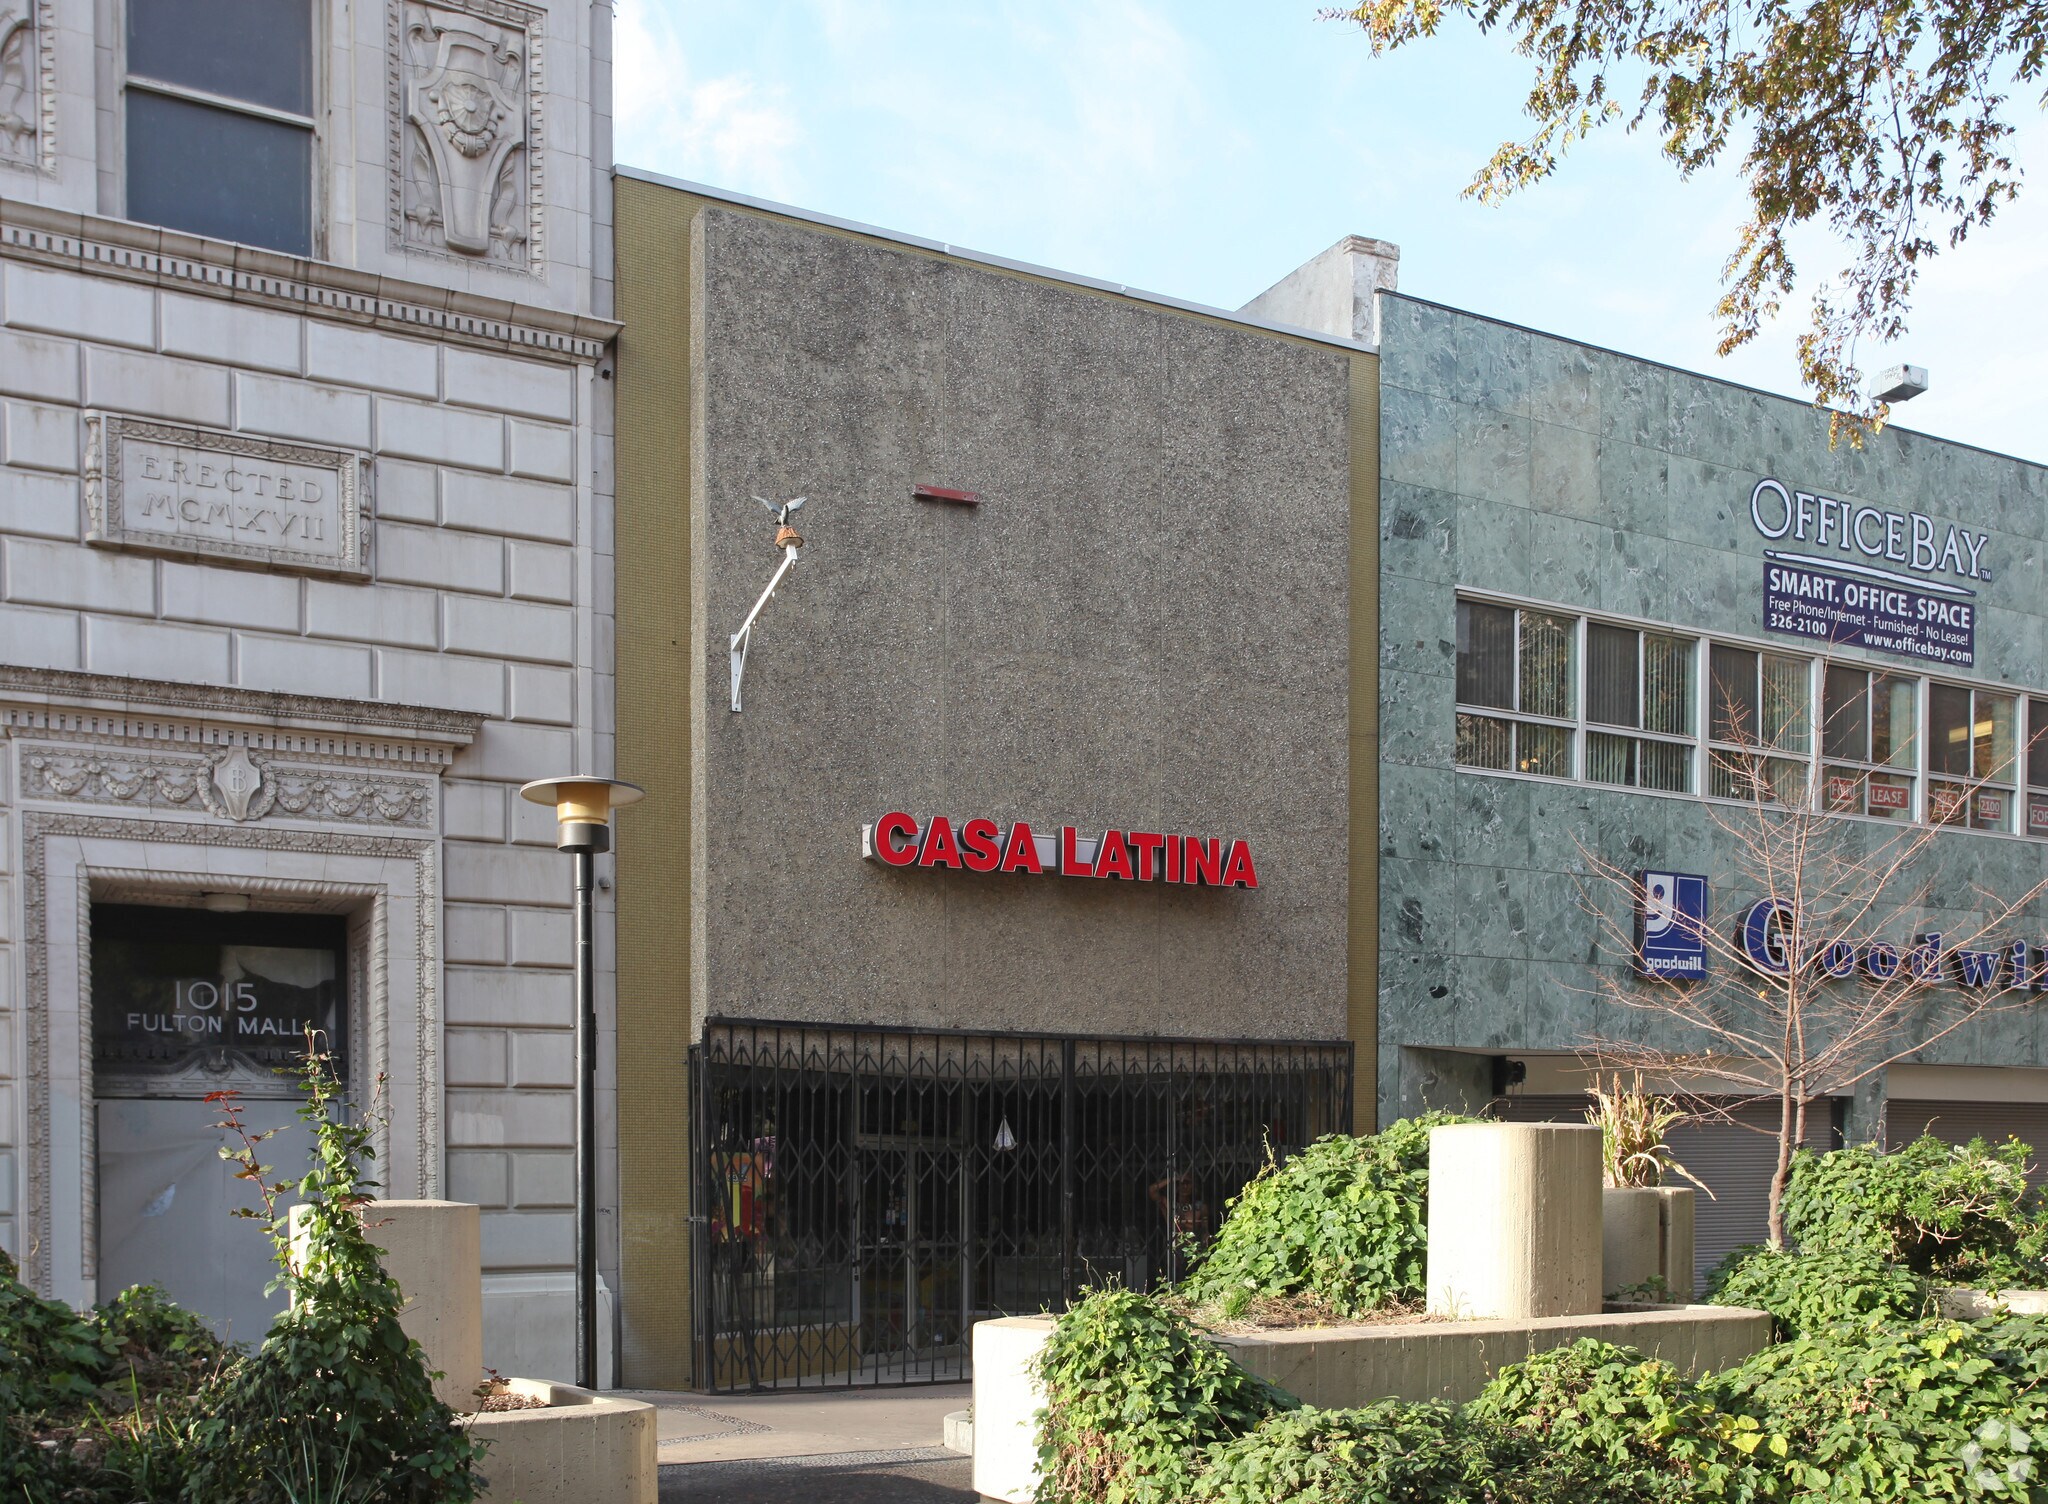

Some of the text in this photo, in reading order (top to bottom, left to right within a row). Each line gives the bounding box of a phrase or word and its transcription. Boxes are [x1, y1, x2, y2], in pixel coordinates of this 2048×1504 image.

[140, 455, 323, 504] ERECTED
[141, 493, 325, 541] MCMXVII
[1769, 568, 1970, 630] SMART. OFFICE. SPACE
[1769, 595, 1791, 612] Free
[1793, 599, 1866, 627] Phone/Internet
[1873, 615, 1919, 636] Furnished
[1925, 625, 1940, 640] No
[1941, 628, 1968, 646] Lease!
[1770, 612, 1827, 635] 326-2100
[1864, 632, 1972, 663] www.officebay.com
[1831, 783, 1903, 804] FOR LEASE
[1980, 800, 2000, 813] 2100
[871, 811, 1259, 889] CASA LATINA
[1646, 955, 1702, 973] goodwill
[174, 981, 258, 1012] 1015
[127, 1013, 304, 1036] FULTON MALL
